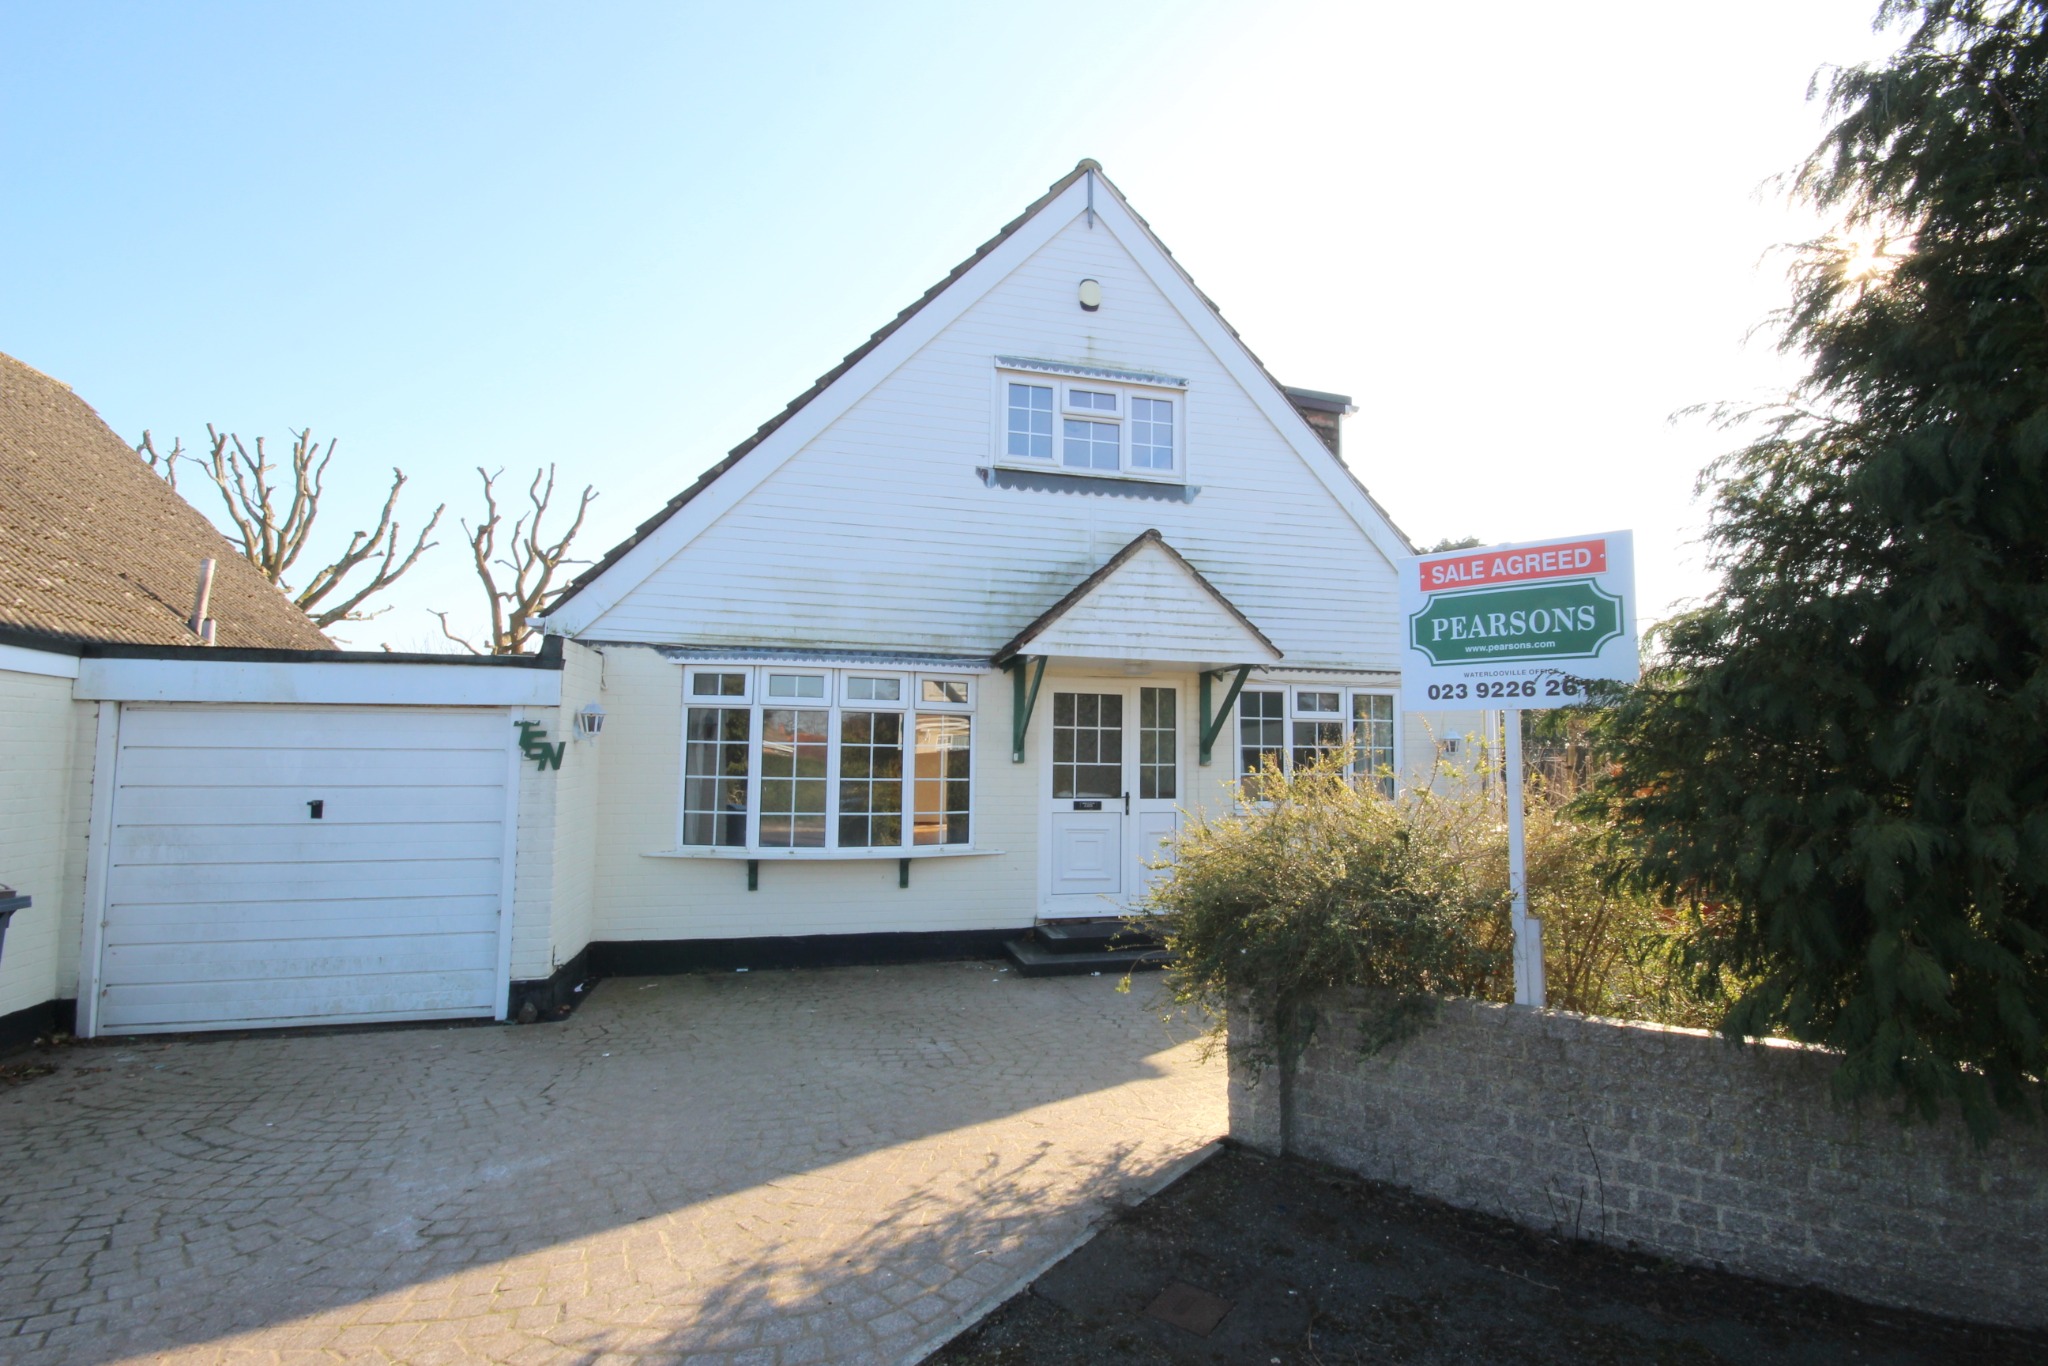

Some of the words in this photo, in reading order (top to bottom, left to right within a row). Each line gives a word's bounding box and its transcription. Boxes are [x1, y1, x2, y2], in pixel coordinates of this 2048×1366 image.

[1431, 560, 1485, 584] SALE
[1491, 548, 1592, 577] AGREED
[1431, 605, 1596, 642] PEARSONS
[1465, 641, 1556, 653] www.pearsons.com
[1463, 670, 1526, 678] WATERLOOVILLE
[1428, 684, 1468, 700] 023
[1476, 681, 1536, 698] 9226
[513, 720, 567, 771] TEN
